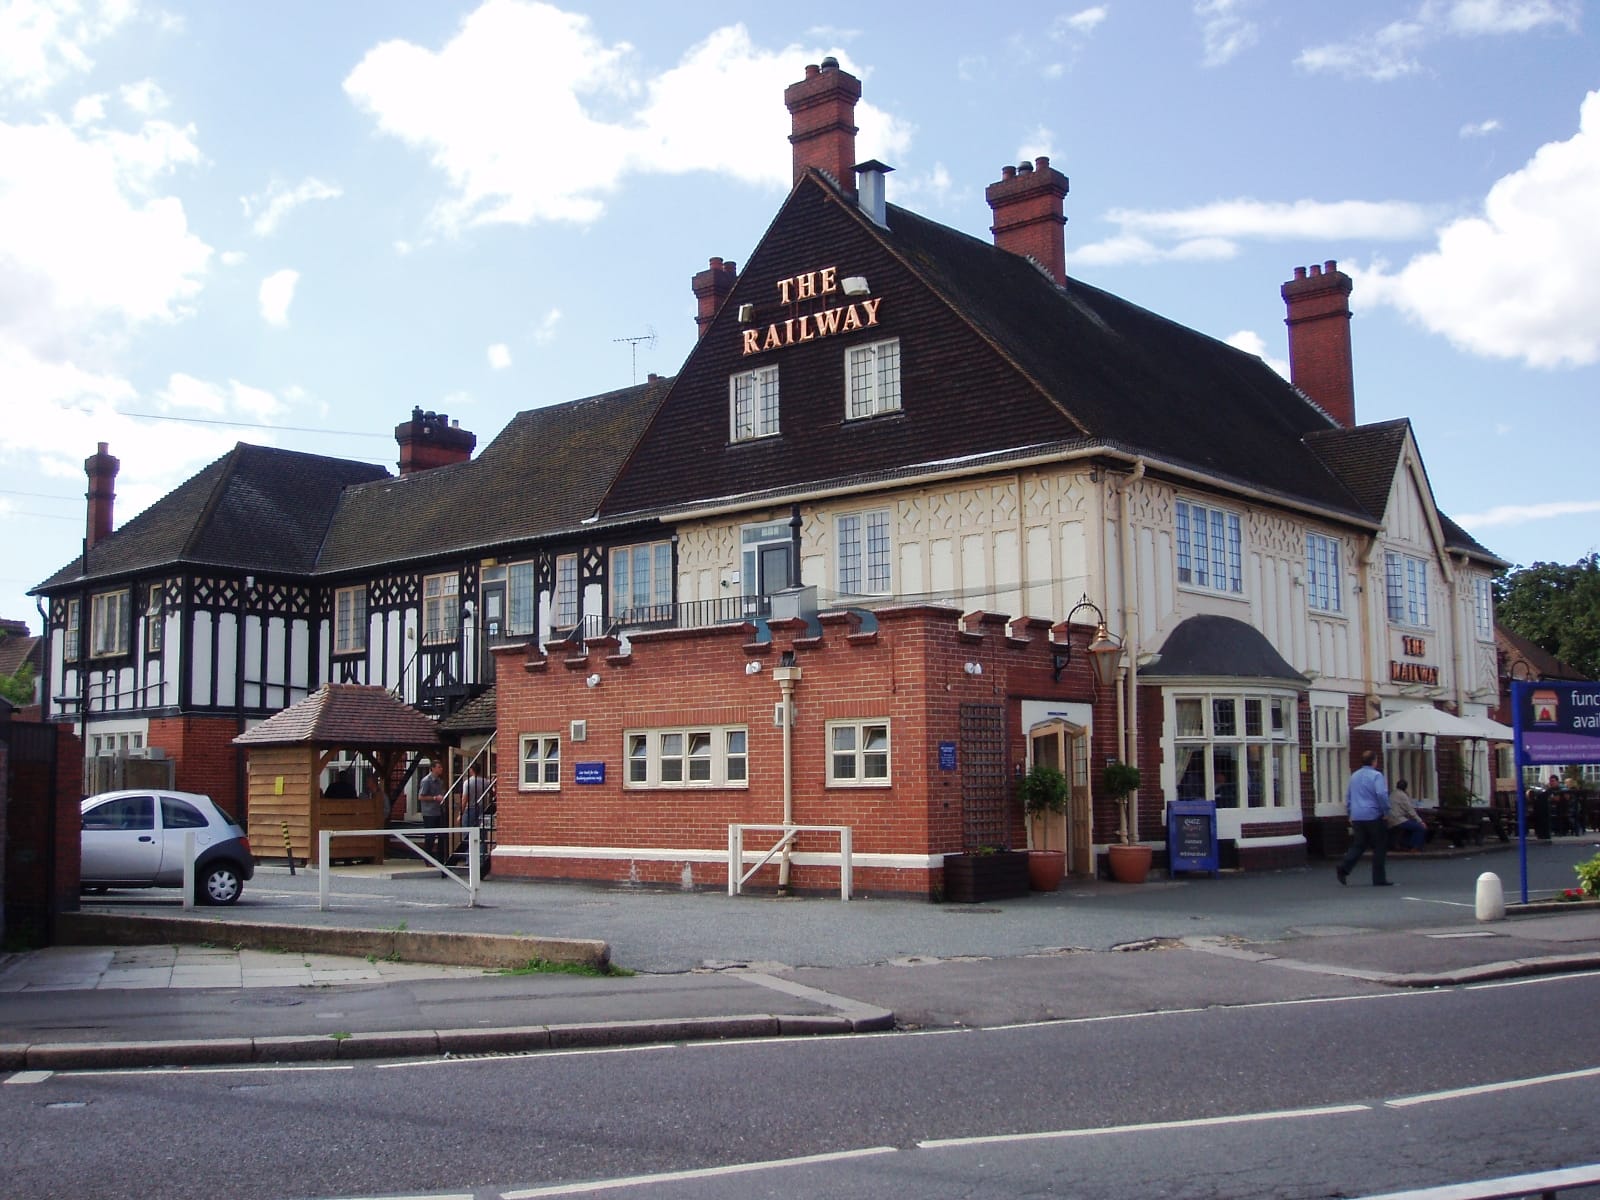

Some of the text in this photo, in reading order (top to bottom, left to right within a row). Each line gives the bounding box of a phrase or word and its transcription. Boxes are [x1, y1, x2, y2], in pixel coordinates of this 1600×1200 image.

[777, 266, 837, 305] THE
[742, 297, 882, 356] RAILWAY
[1402, 635, 1425, 657] THE
[1390, 660, 1439, 686] RAILWAY
[1571, 690, 1600, 706] func
